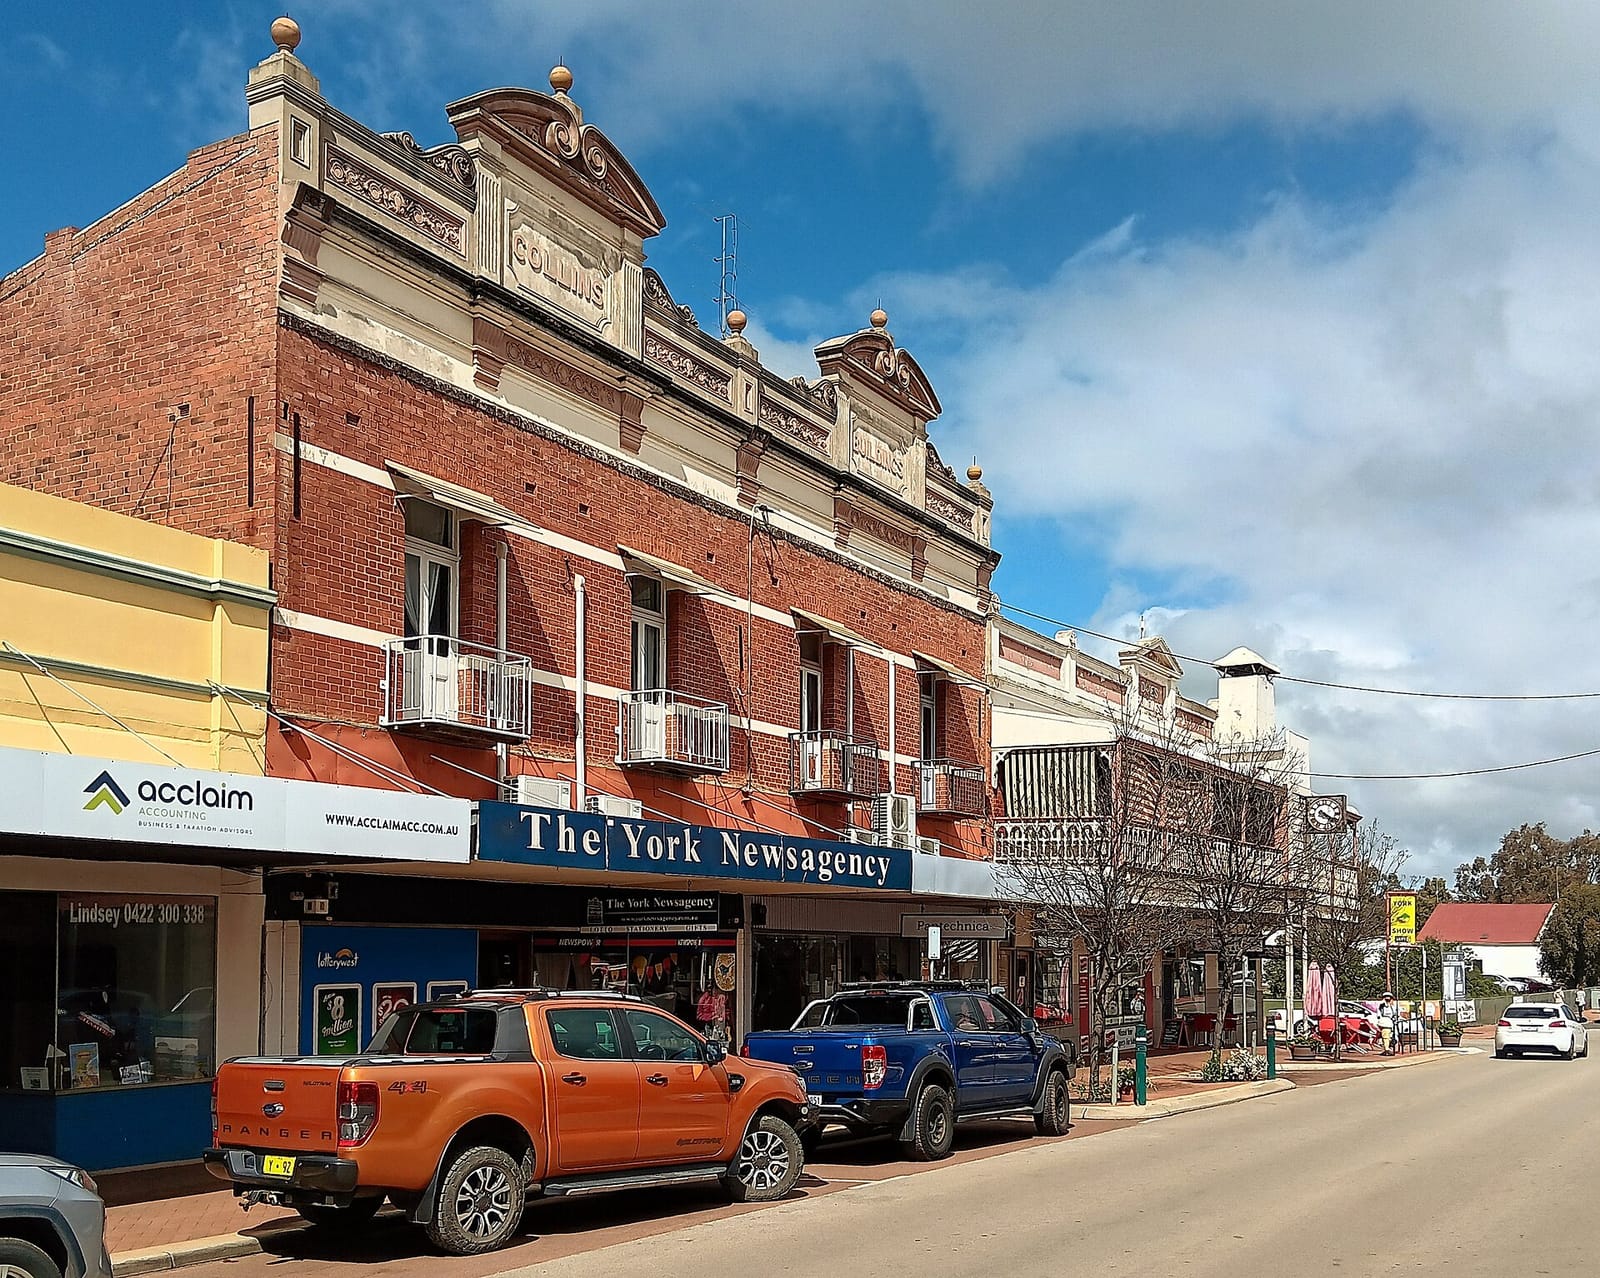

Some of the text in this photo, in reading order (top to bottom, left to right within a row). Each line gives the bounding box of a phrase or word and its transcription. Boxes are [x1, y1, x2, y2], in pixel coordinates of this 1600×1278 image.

[513, 234, 604, 310] COLLINS
[138, 780, 253, 811] acclaim
[139, 807, 207, 821] ACCOUNTING
[138, 820, 173, 829] BUSINESS
[220, 827, 253, 835] ADVISORS
[325, 813, 459, 836] WWW.ACCLAIMACC.COM.AU
[520, 811, 891, 886] The York Newsagency
[607, 897, 715, 909] The York Newsagency
[70, 902, 205, 928] Lindsey 0422 300 338
[317, 952, 359, 969] lotterywest
[321, 1018, 354, 1038] million
[223, 1125, 333, 1141] RANGER
